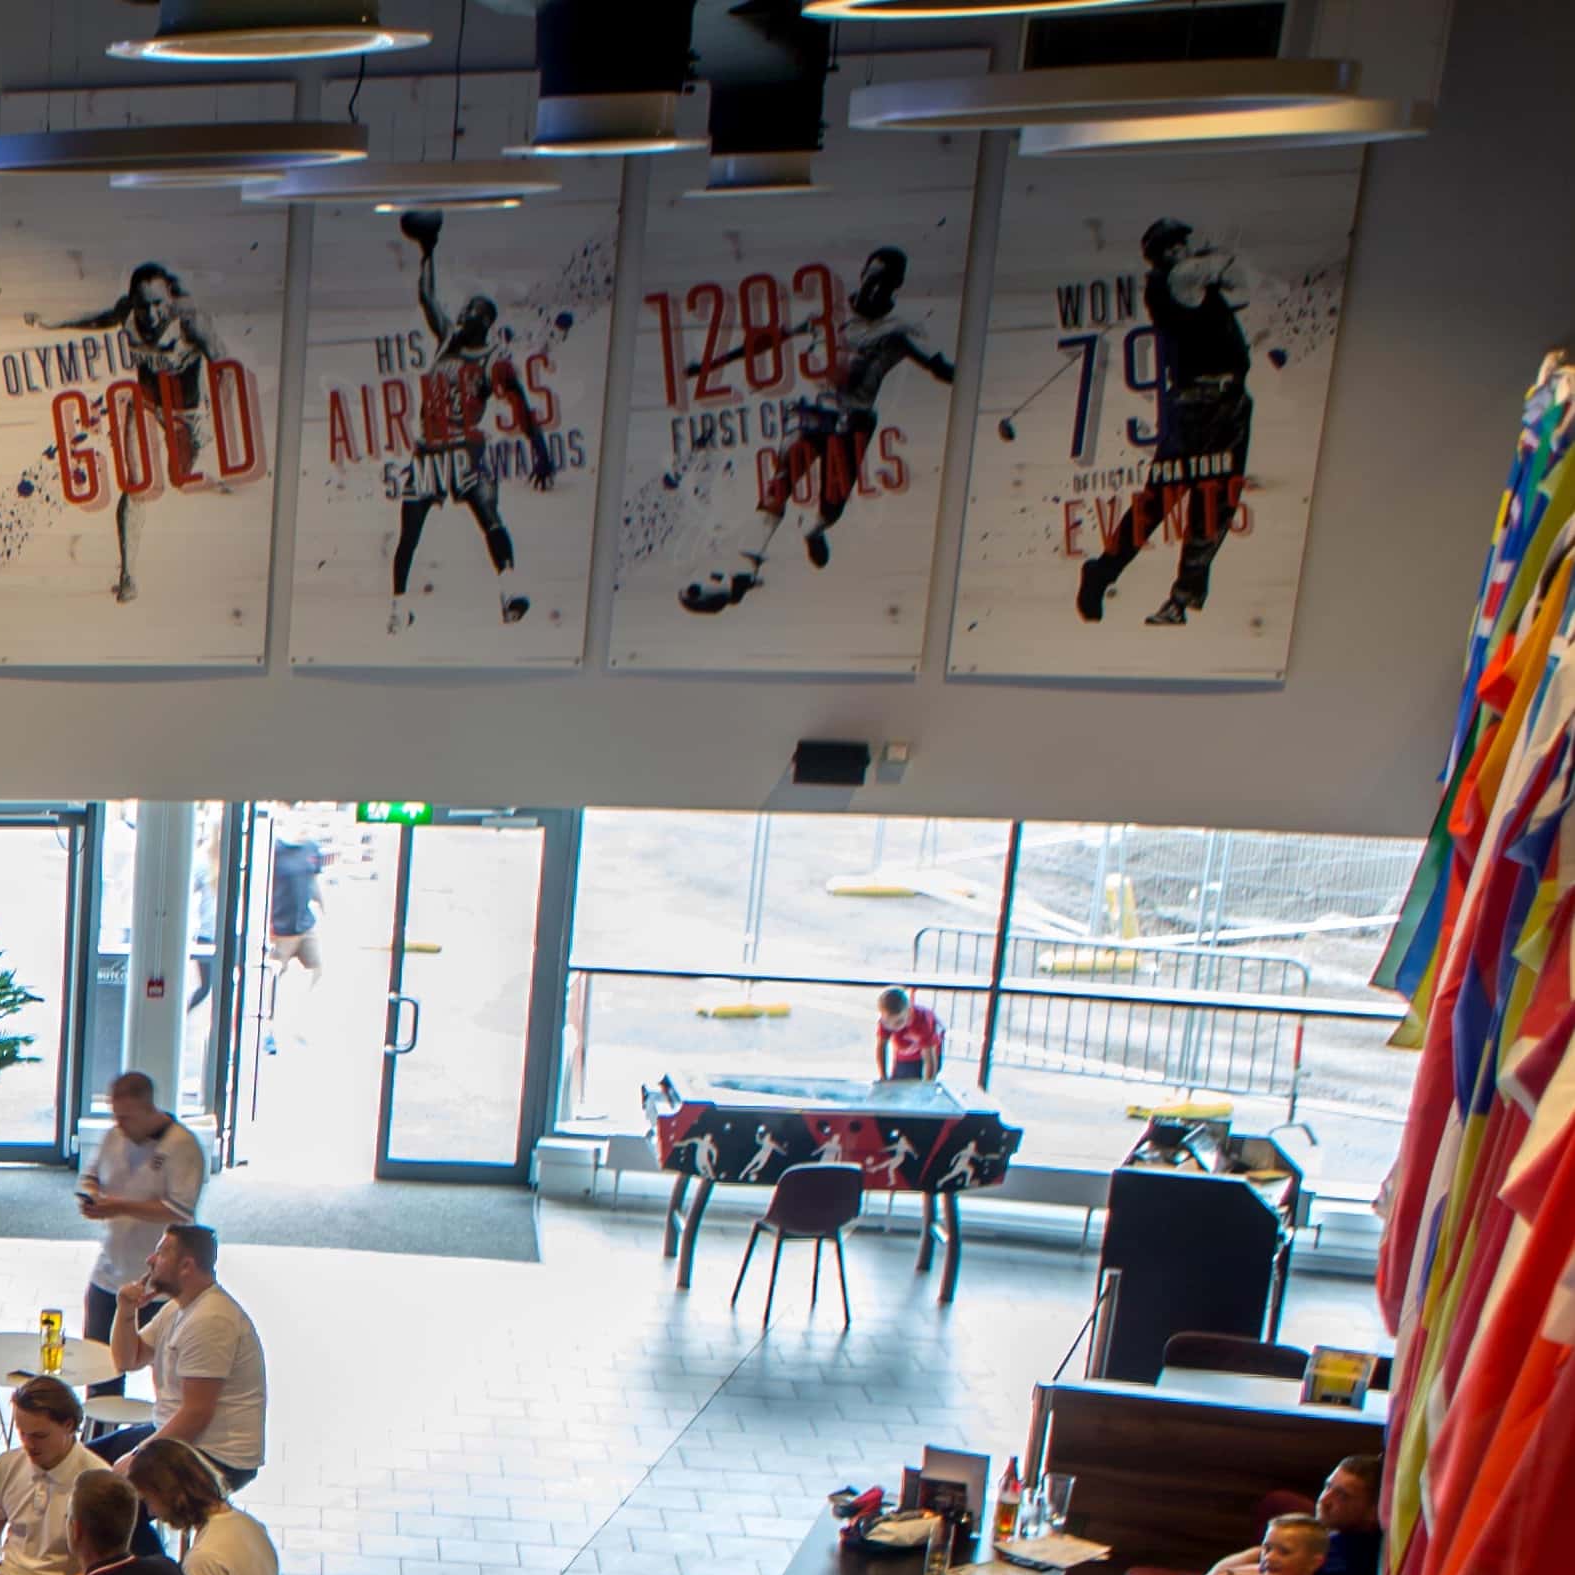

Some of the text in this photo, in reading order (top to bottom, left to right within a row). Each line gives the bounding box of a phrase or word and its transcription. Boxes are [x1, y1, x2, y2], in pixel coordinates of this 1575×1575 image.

[644, 263, 840, 408] 1283
[1057, 275, 1137, 329] WON
[2, 329, 137, 396] OLYMPIC
[375, 330, 426, 375] HIS
[329, 353, 558, 464] AIRNESS
[1057, 324, 1167, 460] 79
[52, 358, 262, 508] GOLD
[672, 406, 749, 455] FIRST
[756, 426, 908, 504] GOALS
[414, 449, 471, 499] MVP
[1152, 459, 1184, 485] PGA
[1189, 452, 1234, 478] TOUR
[1062, 476, 1255, 559] EVENTS
